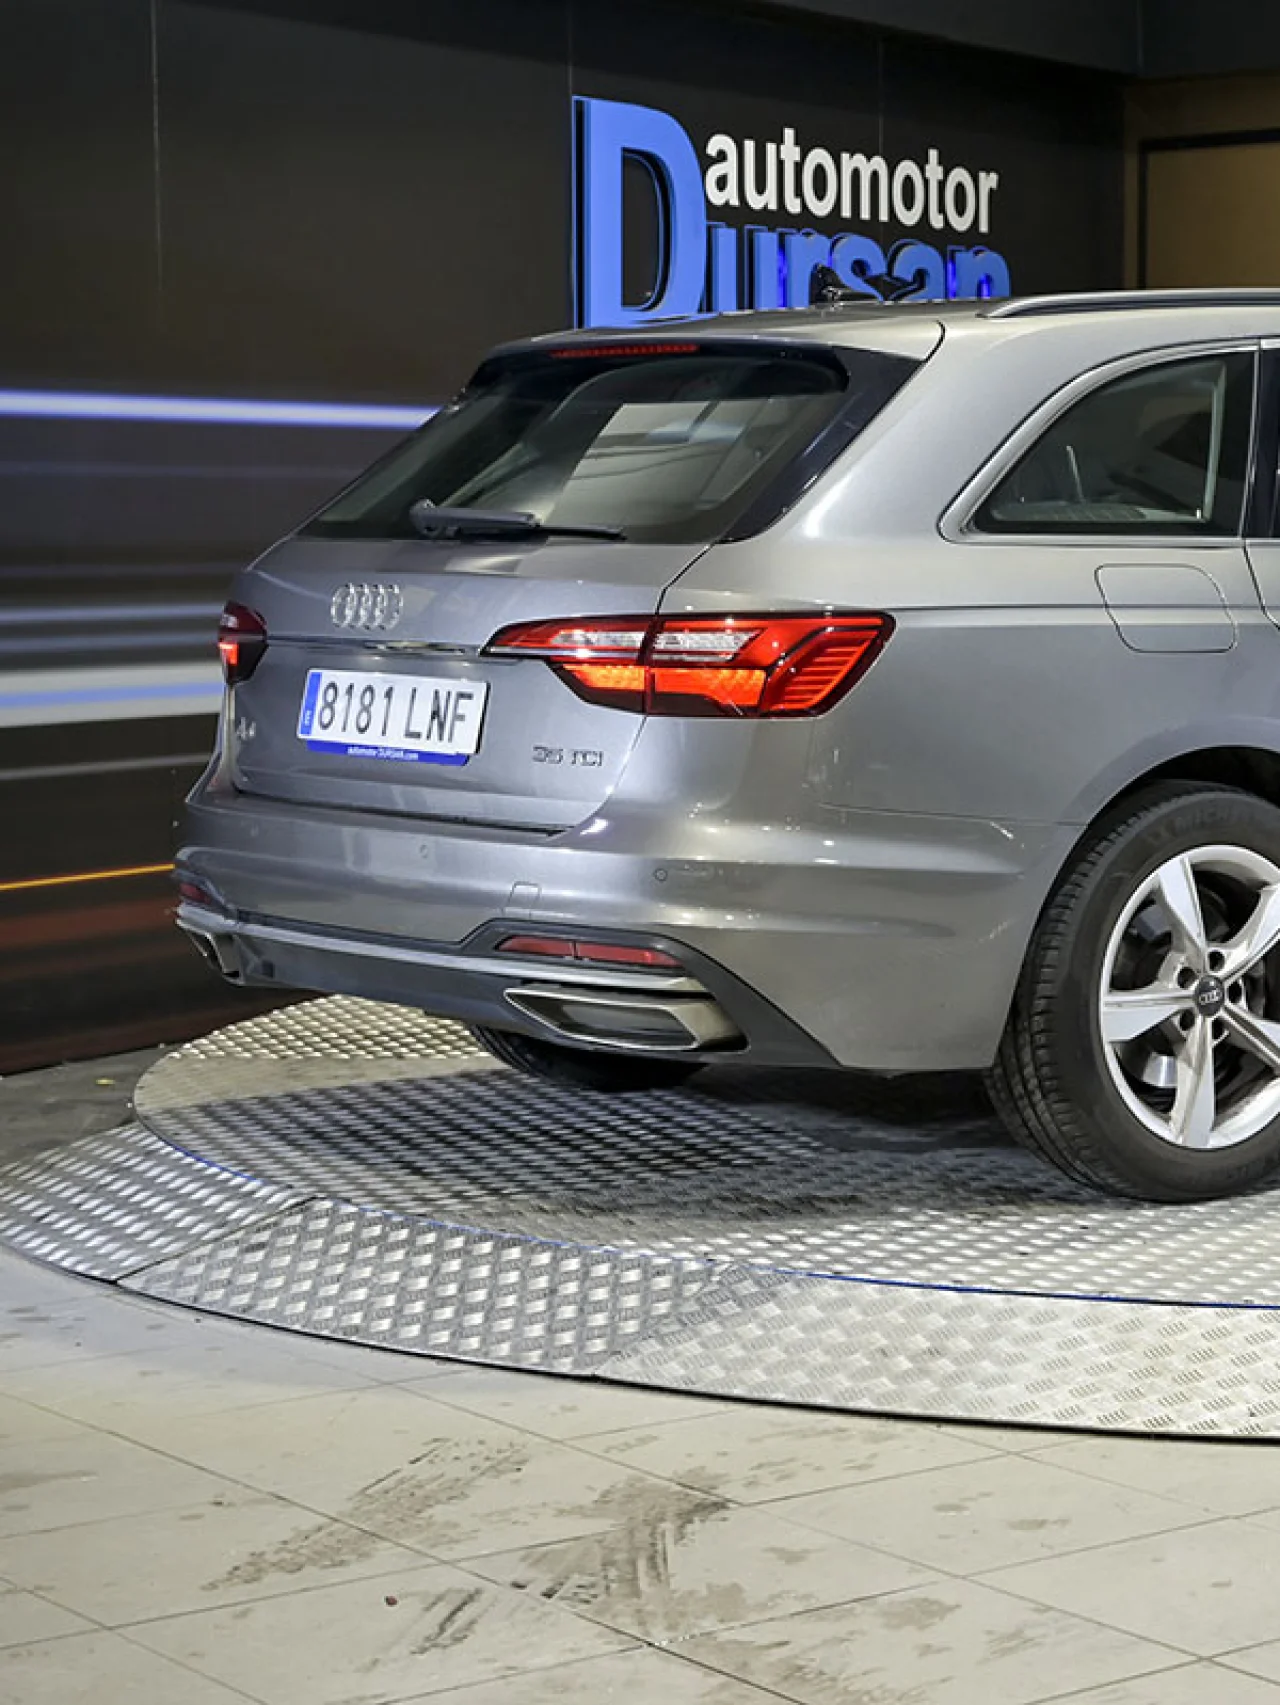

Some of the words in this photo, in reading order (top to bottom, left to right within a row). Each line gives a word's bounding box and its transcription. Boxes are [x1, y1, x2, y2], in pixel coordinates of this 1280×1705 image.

[705, 127, 999, 233] automotor
[319, 681, 395, 737] 8181
[404, 686, 474, 743] LNF
